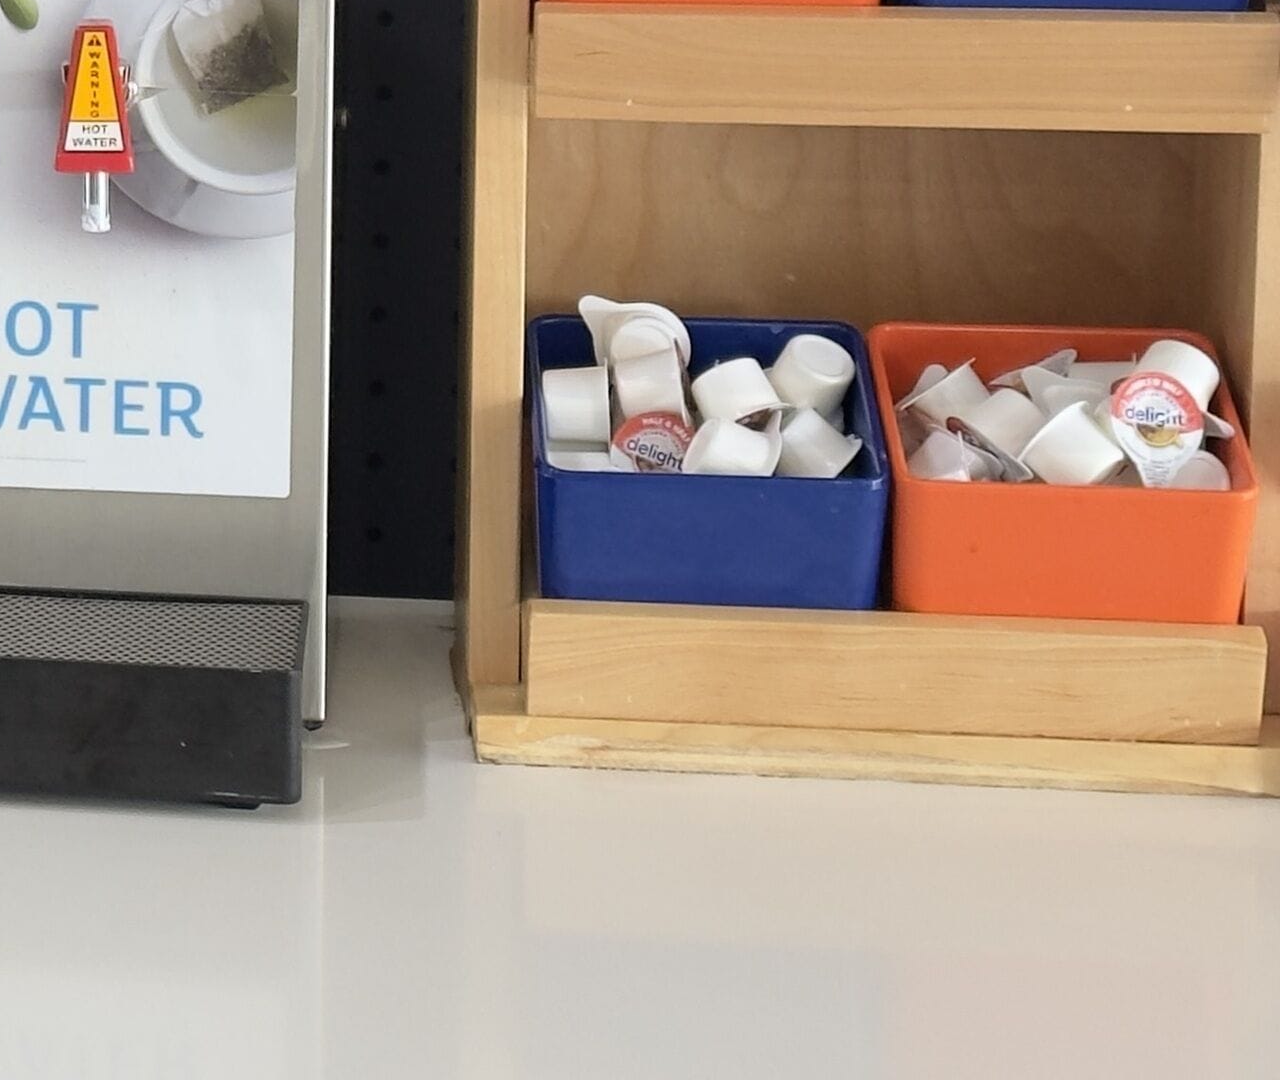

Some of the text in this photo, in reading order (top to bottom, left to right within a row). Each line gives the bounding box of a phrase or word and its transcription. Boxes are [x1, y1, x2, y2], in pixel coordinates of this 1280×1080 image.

[88, 51, 101, 119] WARNING
[82, 124, 108, 135] HOT
[72, 137, 118, 148] WATER
